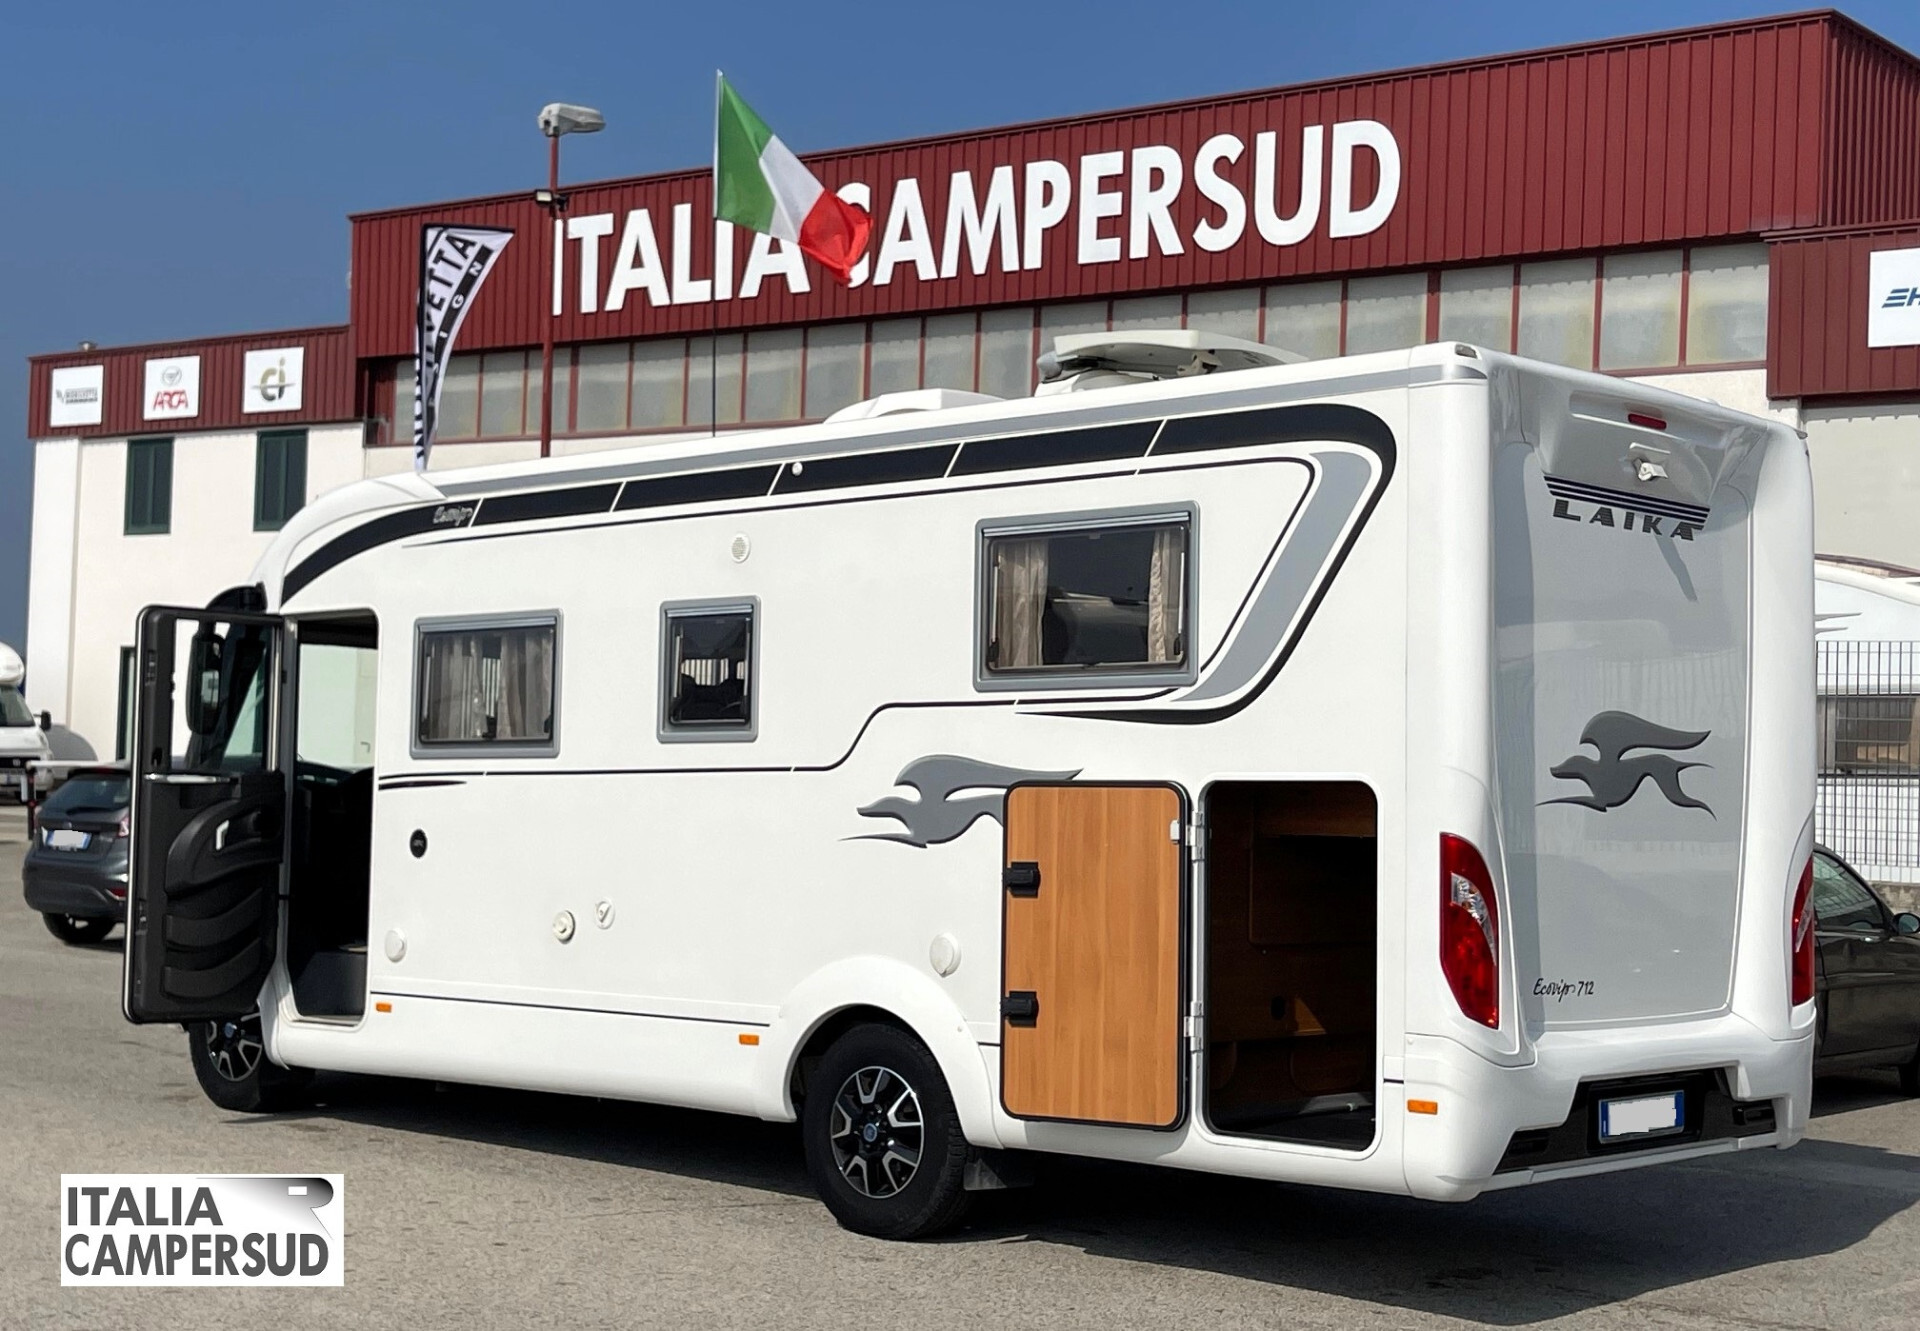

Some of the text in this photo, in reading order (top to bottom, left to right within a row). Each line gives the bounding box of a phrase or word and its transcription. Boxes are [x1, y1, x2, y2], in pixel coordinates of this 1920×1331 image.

[552, 203, 811, 316] ITALIA
[153, 389, 189, 411] ARCA
[1553, 499, 1704, 541] LAIKA
[1577, 980, 1595, 997] 712
